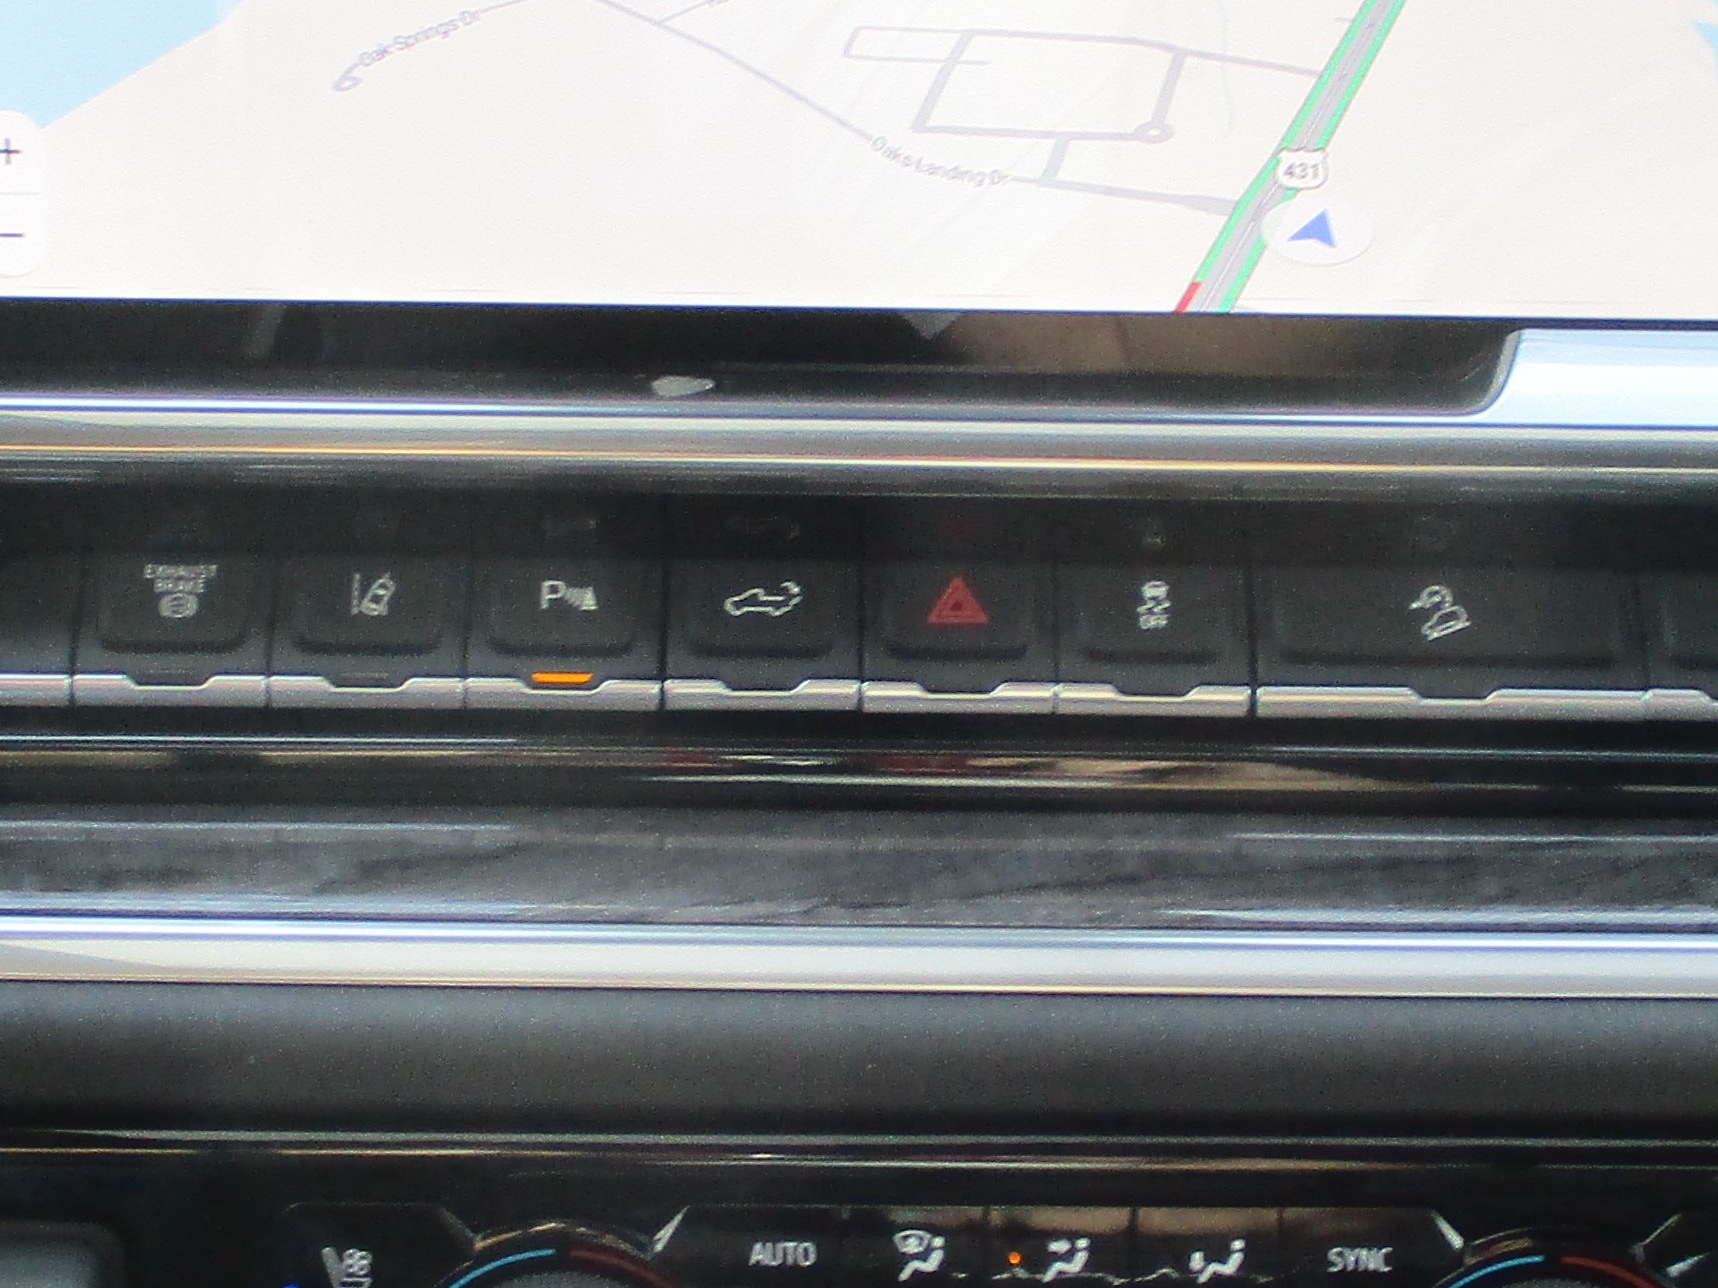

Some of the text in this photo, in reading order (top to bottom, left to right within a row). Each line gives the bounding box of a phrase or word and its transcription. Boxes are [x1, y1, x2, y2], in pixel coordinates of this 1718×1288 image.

[357, 10, 482, 67] Oak Springs Dr
[1282, 161, 1320, 180] 431
[154, 578, 205, 593] BRAKE
[748, 1241, 817, 1267] AUTO
[1327, 1246, 1394, 1273] SYNC
